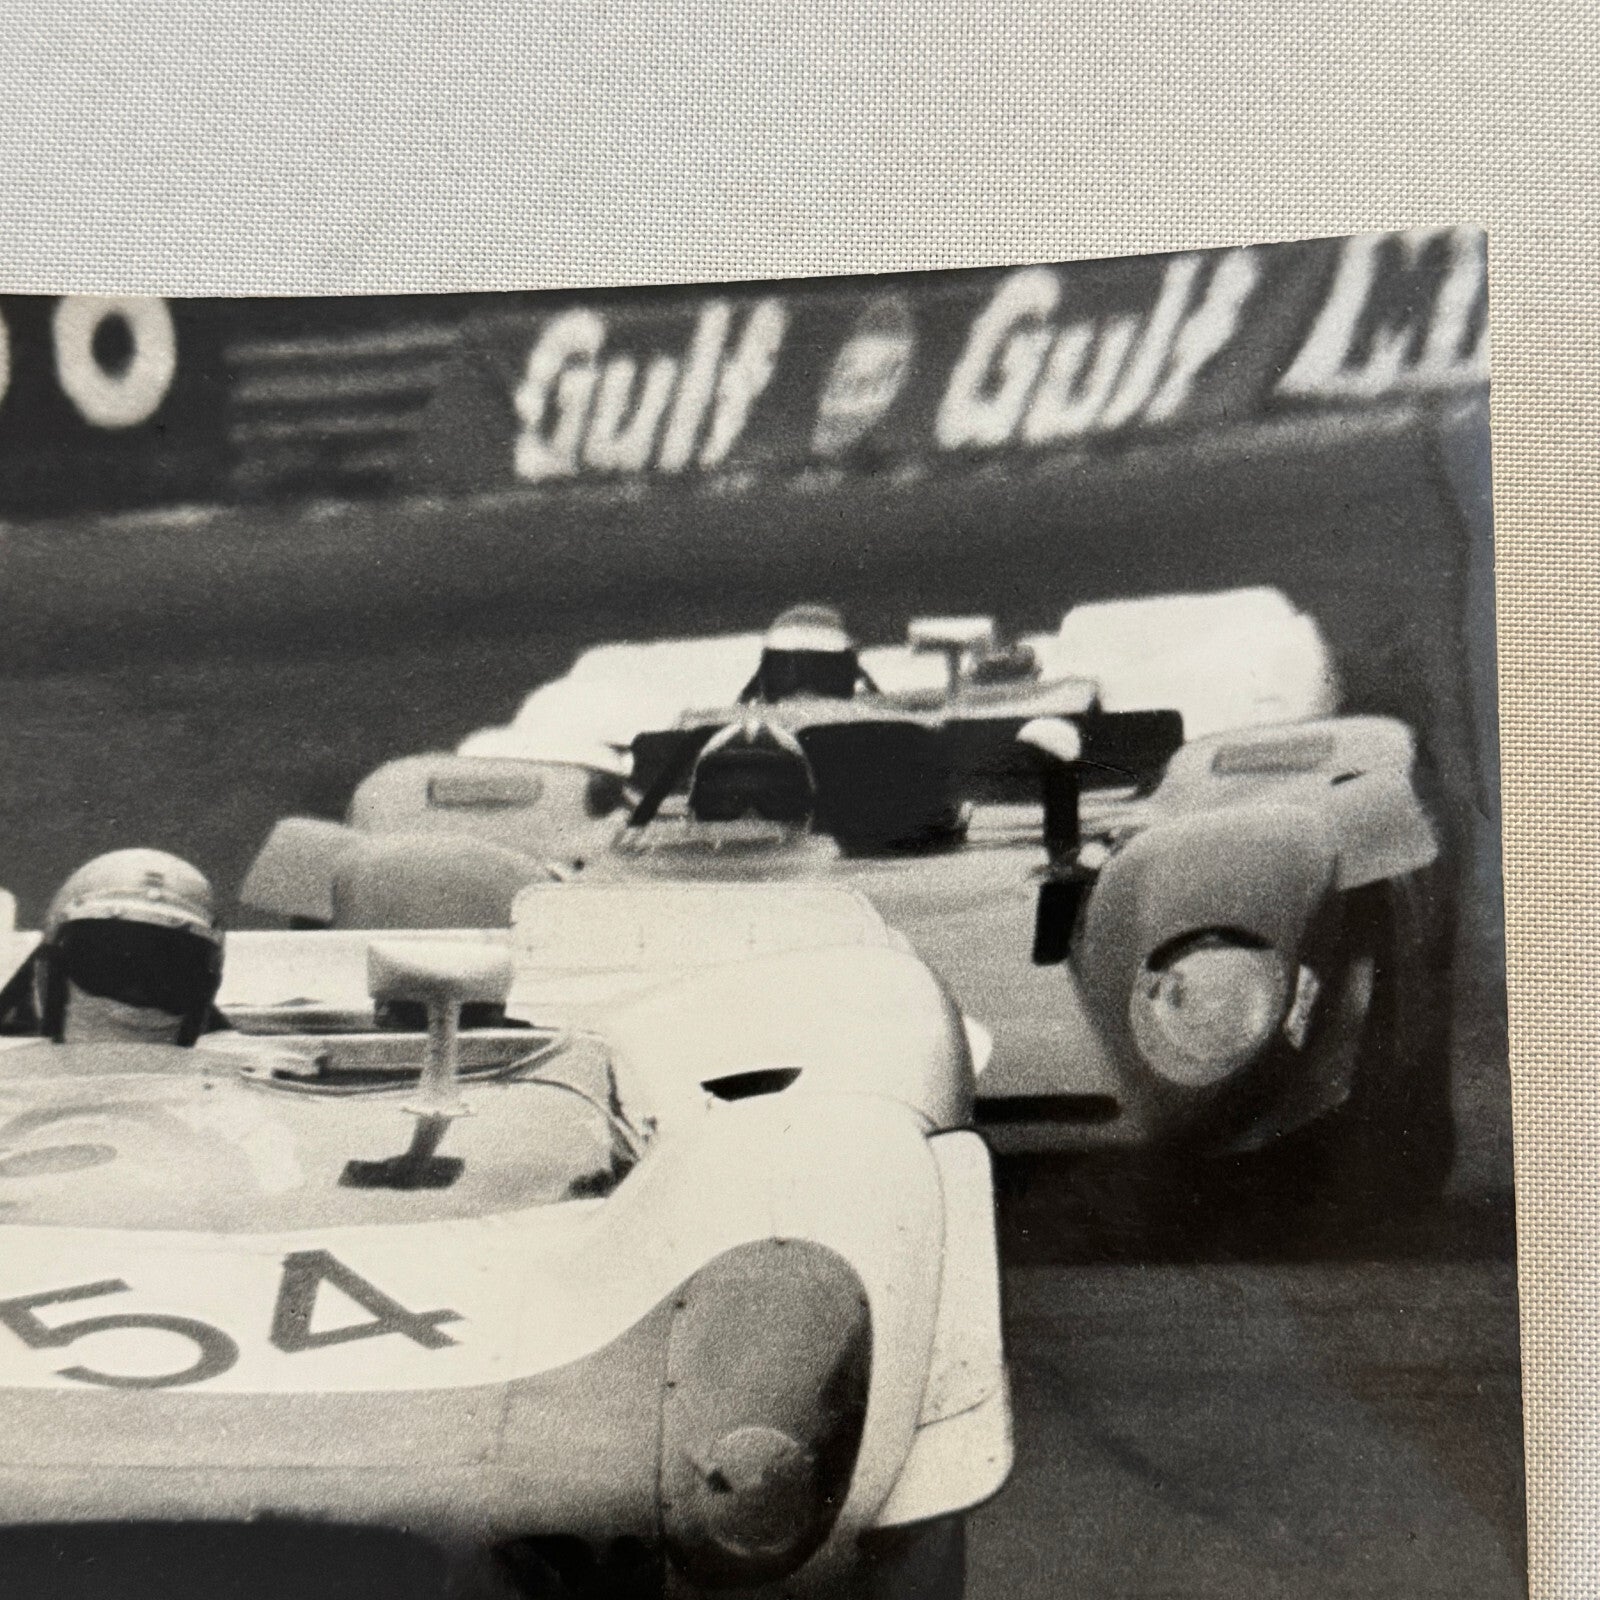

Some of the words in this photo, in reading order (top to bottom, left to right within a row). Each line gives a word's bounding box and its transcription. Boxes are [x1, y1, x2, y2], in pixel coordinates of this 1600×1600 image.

[514, 298, 788, 480] Gulf
[936, 246, 1261, 449] Gulf
[0, 1248, 466, 1390] 54
